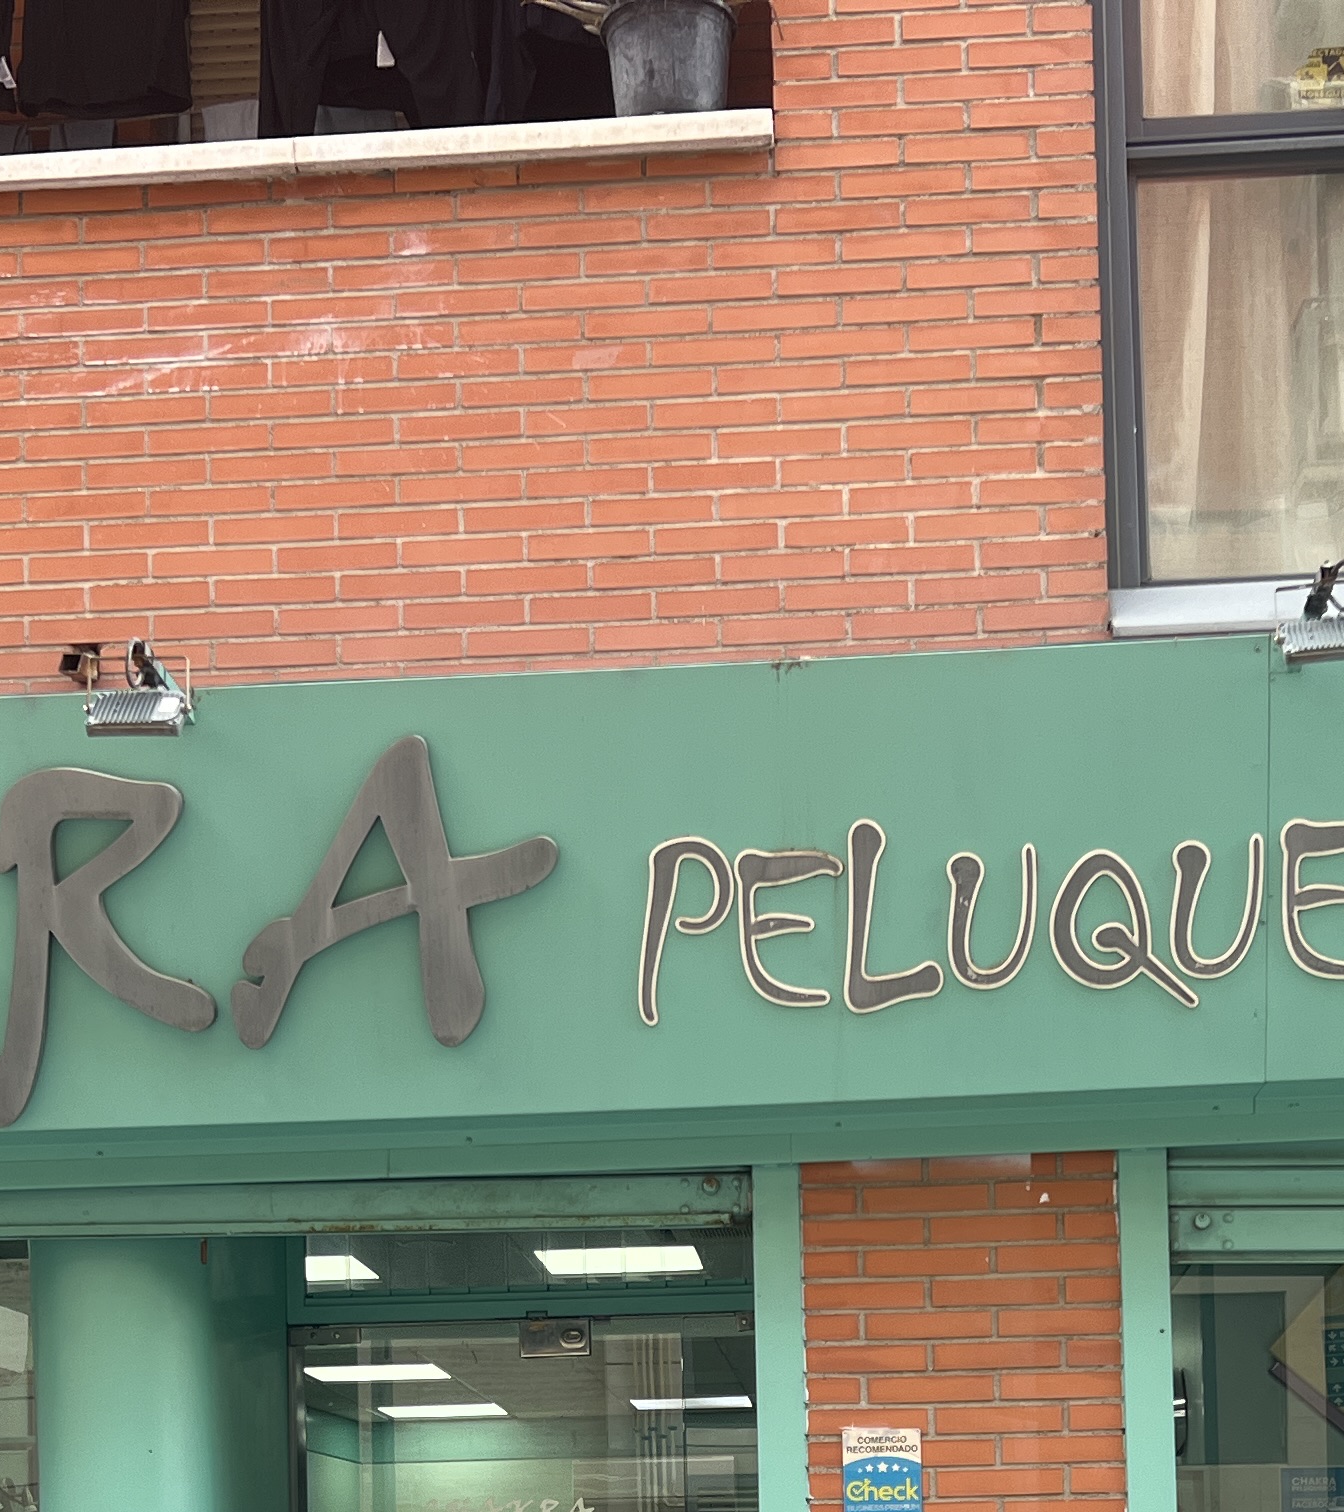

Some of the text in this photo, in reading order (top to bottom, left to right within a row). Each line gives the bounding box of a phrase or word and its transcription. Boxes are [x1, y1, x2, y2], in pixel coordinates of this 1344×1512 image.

[857, 1435, 907, 1445] COMERCIO
[846, 1444, 918, 1454] RECOMENDADO
[846, 1477, 919, 1501] Check
